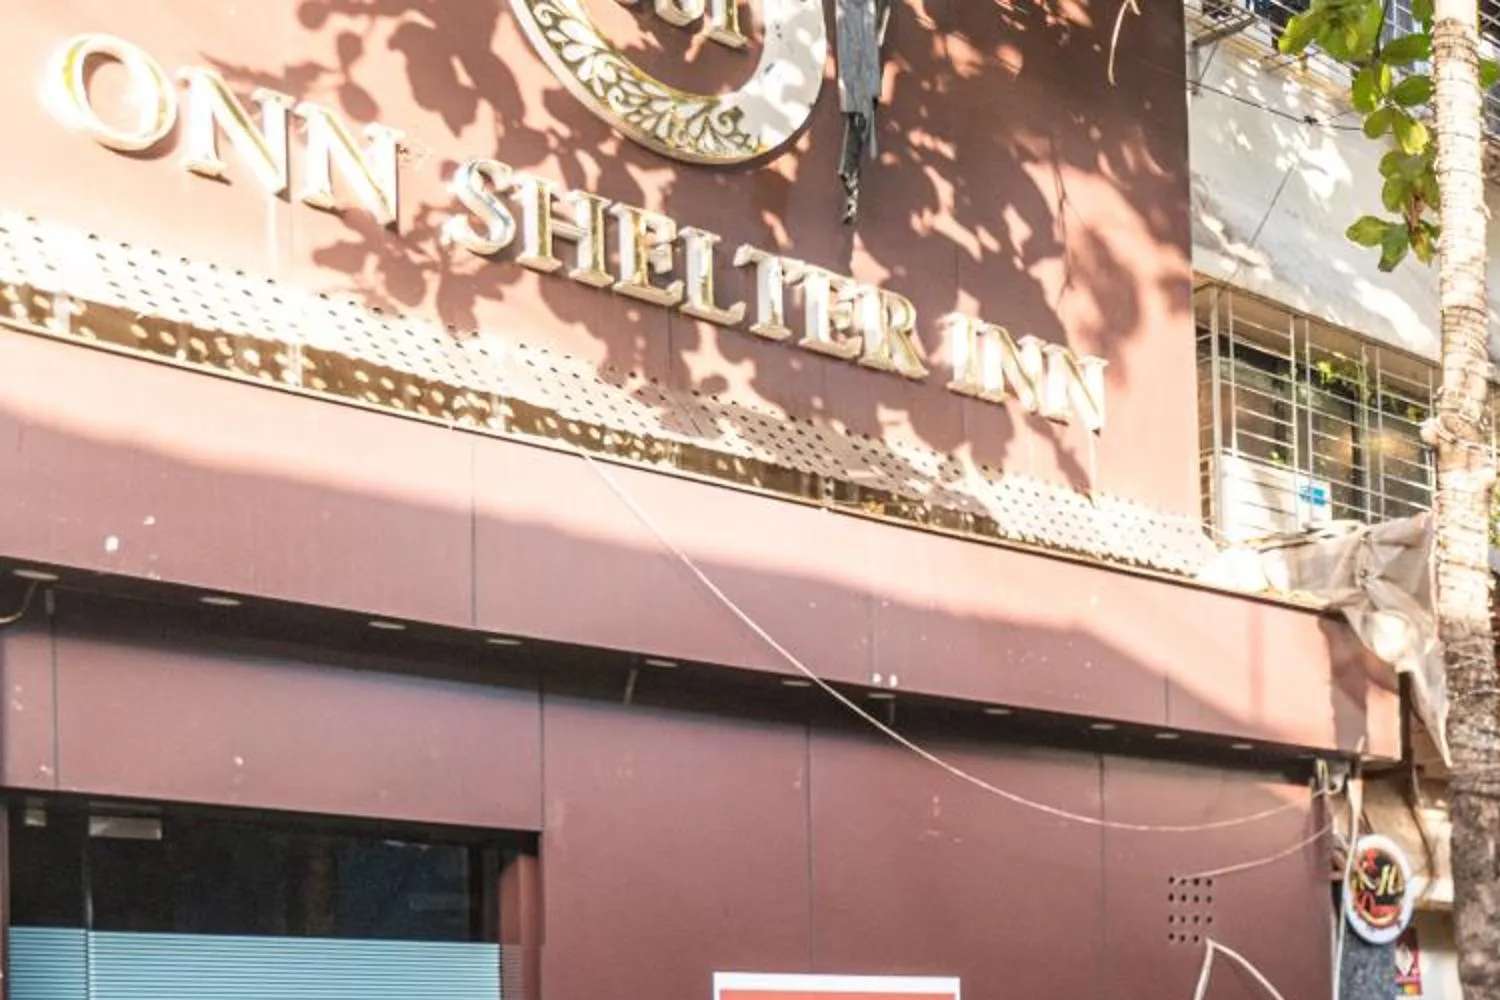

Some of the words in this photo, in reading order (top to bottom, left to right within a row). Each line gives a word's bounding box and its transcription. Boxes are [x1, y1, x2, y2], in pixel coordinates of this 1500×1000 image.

[42, 34, 402, 228] ONN
[442, 157, 928, 381] SHELTER
[947, 311, 1110, 434] INN
